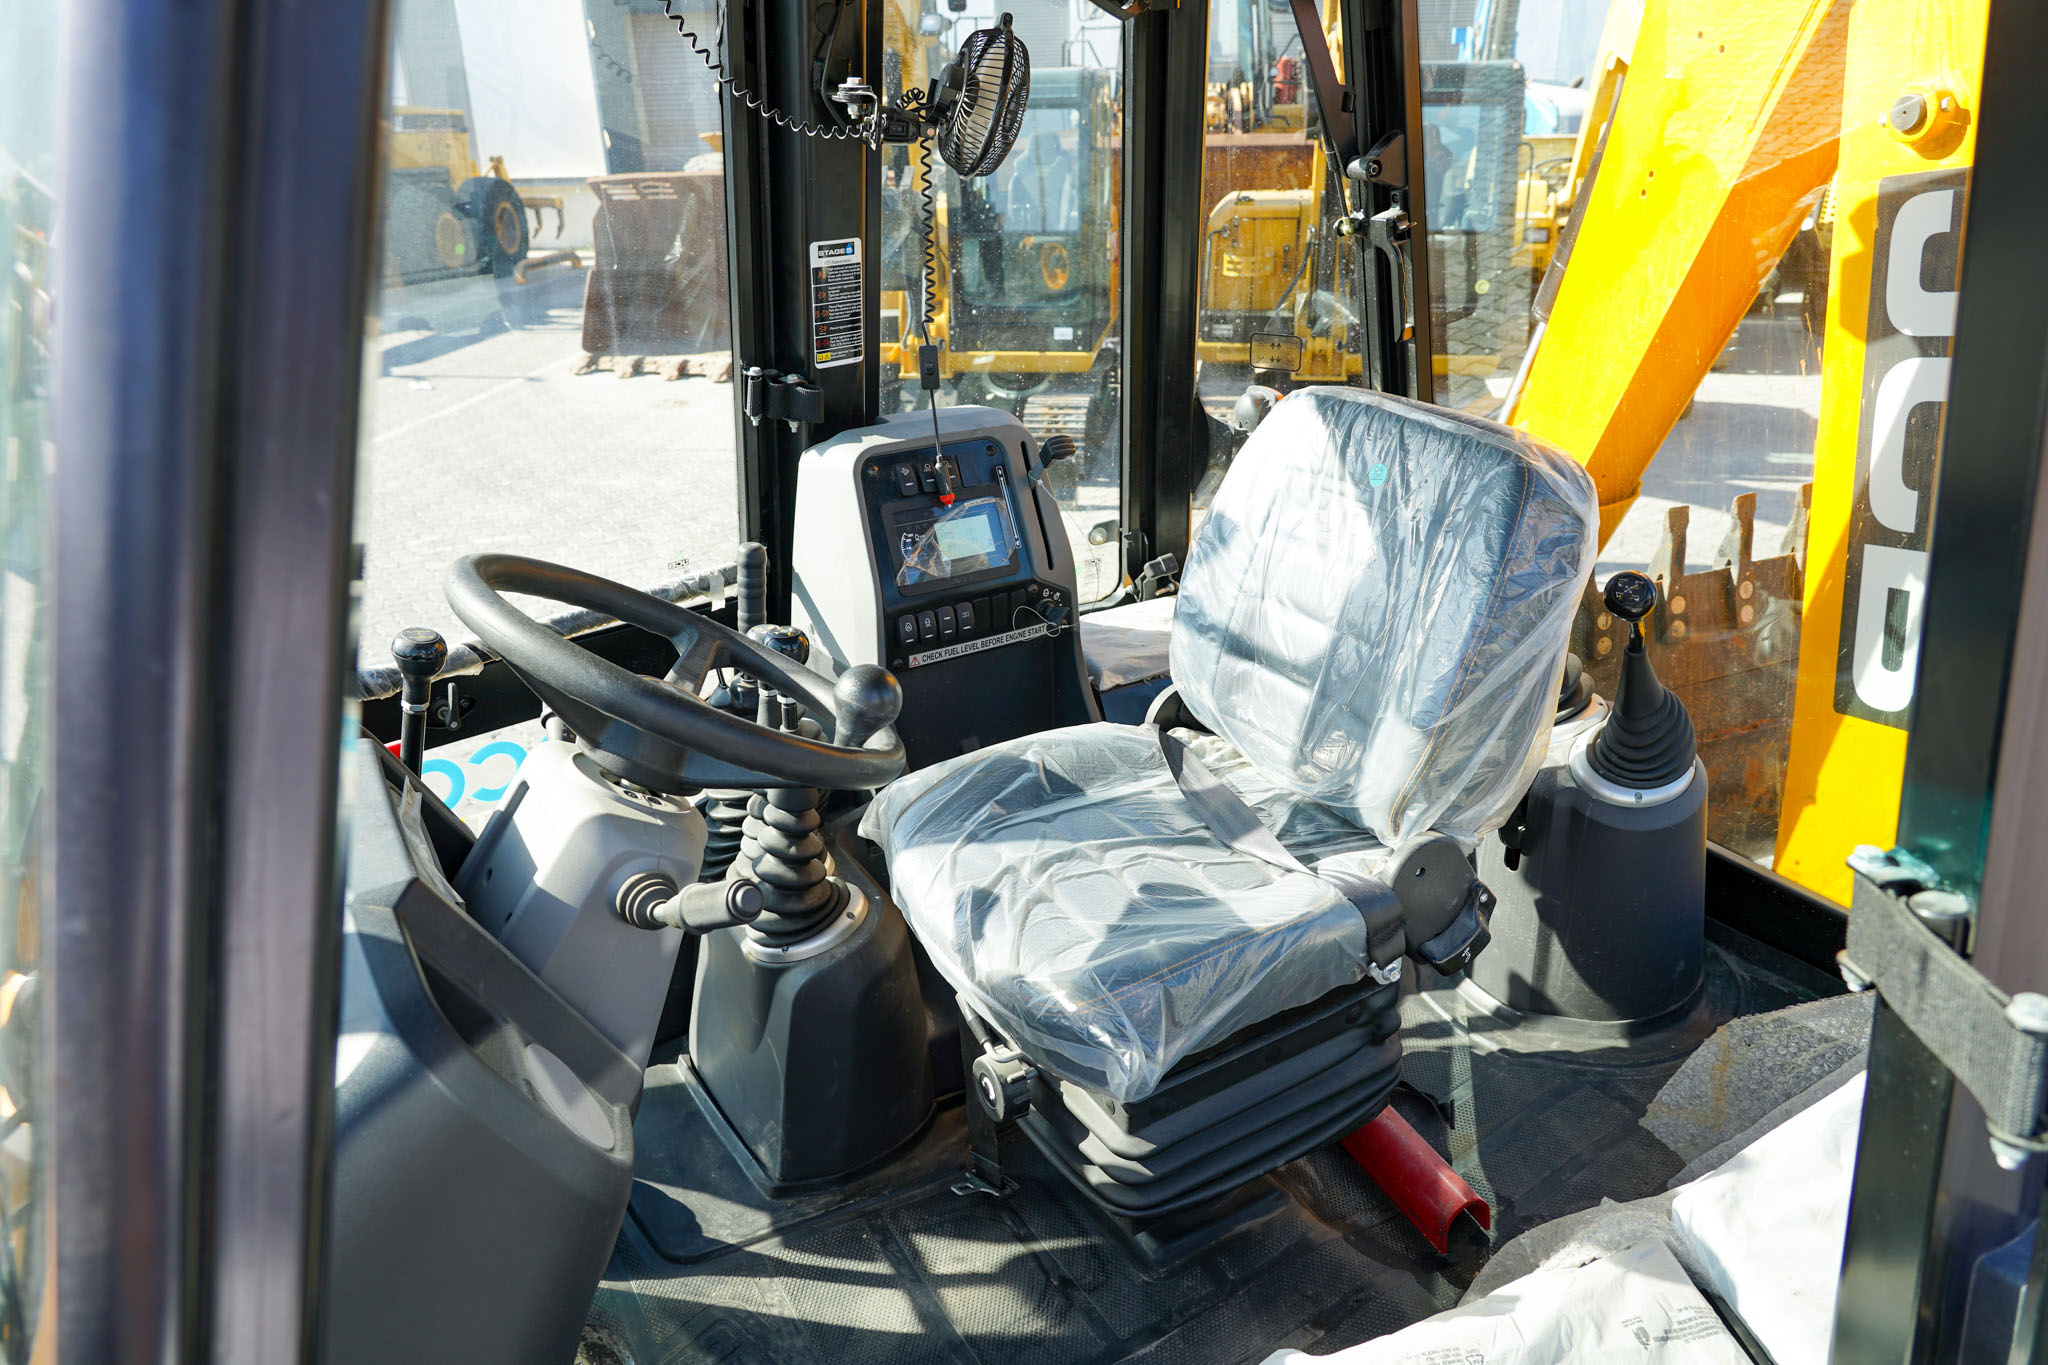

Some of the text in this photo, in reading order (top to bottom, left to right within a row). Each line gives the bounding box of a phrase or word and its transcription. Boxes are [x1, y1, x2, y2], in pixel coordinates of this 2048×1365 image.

[818, 247, 845, 257] STAGE
[922, 625, 1046, 663] CHECK FUEL LEVEL BEFORE ENGINE START
